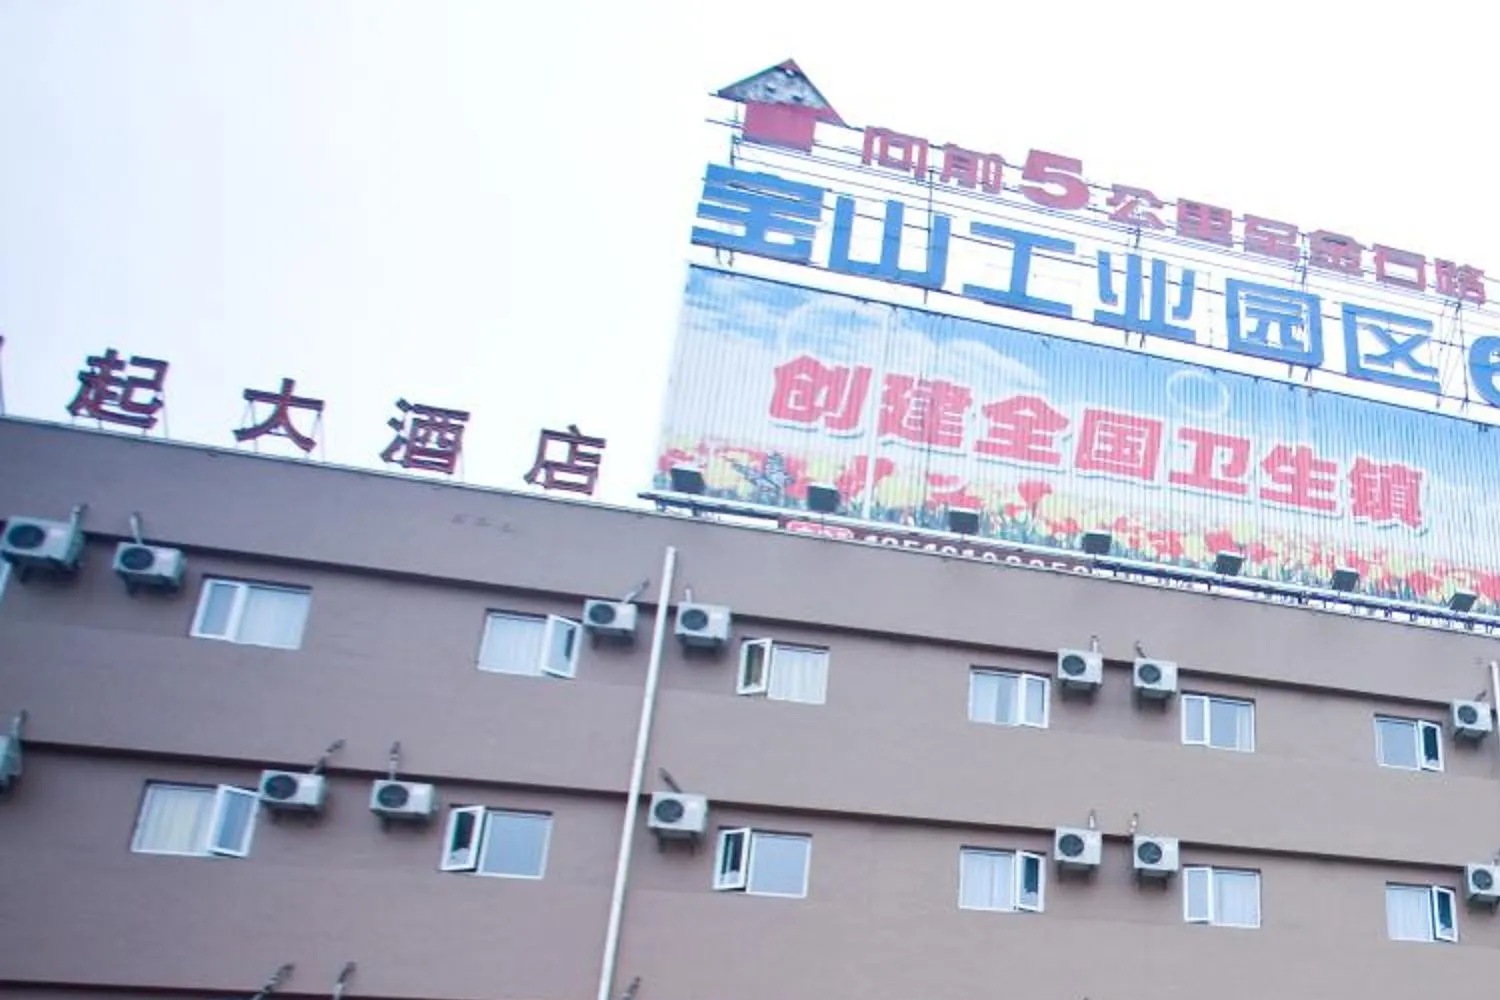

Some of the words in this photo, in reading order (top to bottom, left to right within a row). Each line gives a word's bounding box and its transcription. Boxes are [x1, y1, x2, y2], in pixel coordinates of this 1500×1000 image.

[690, 163, 1440, 394] 宝山工业园区
[0, 336, 607, 496] 起大酒店
[768, 355, 1424, 529] 创建全国卫生镇
